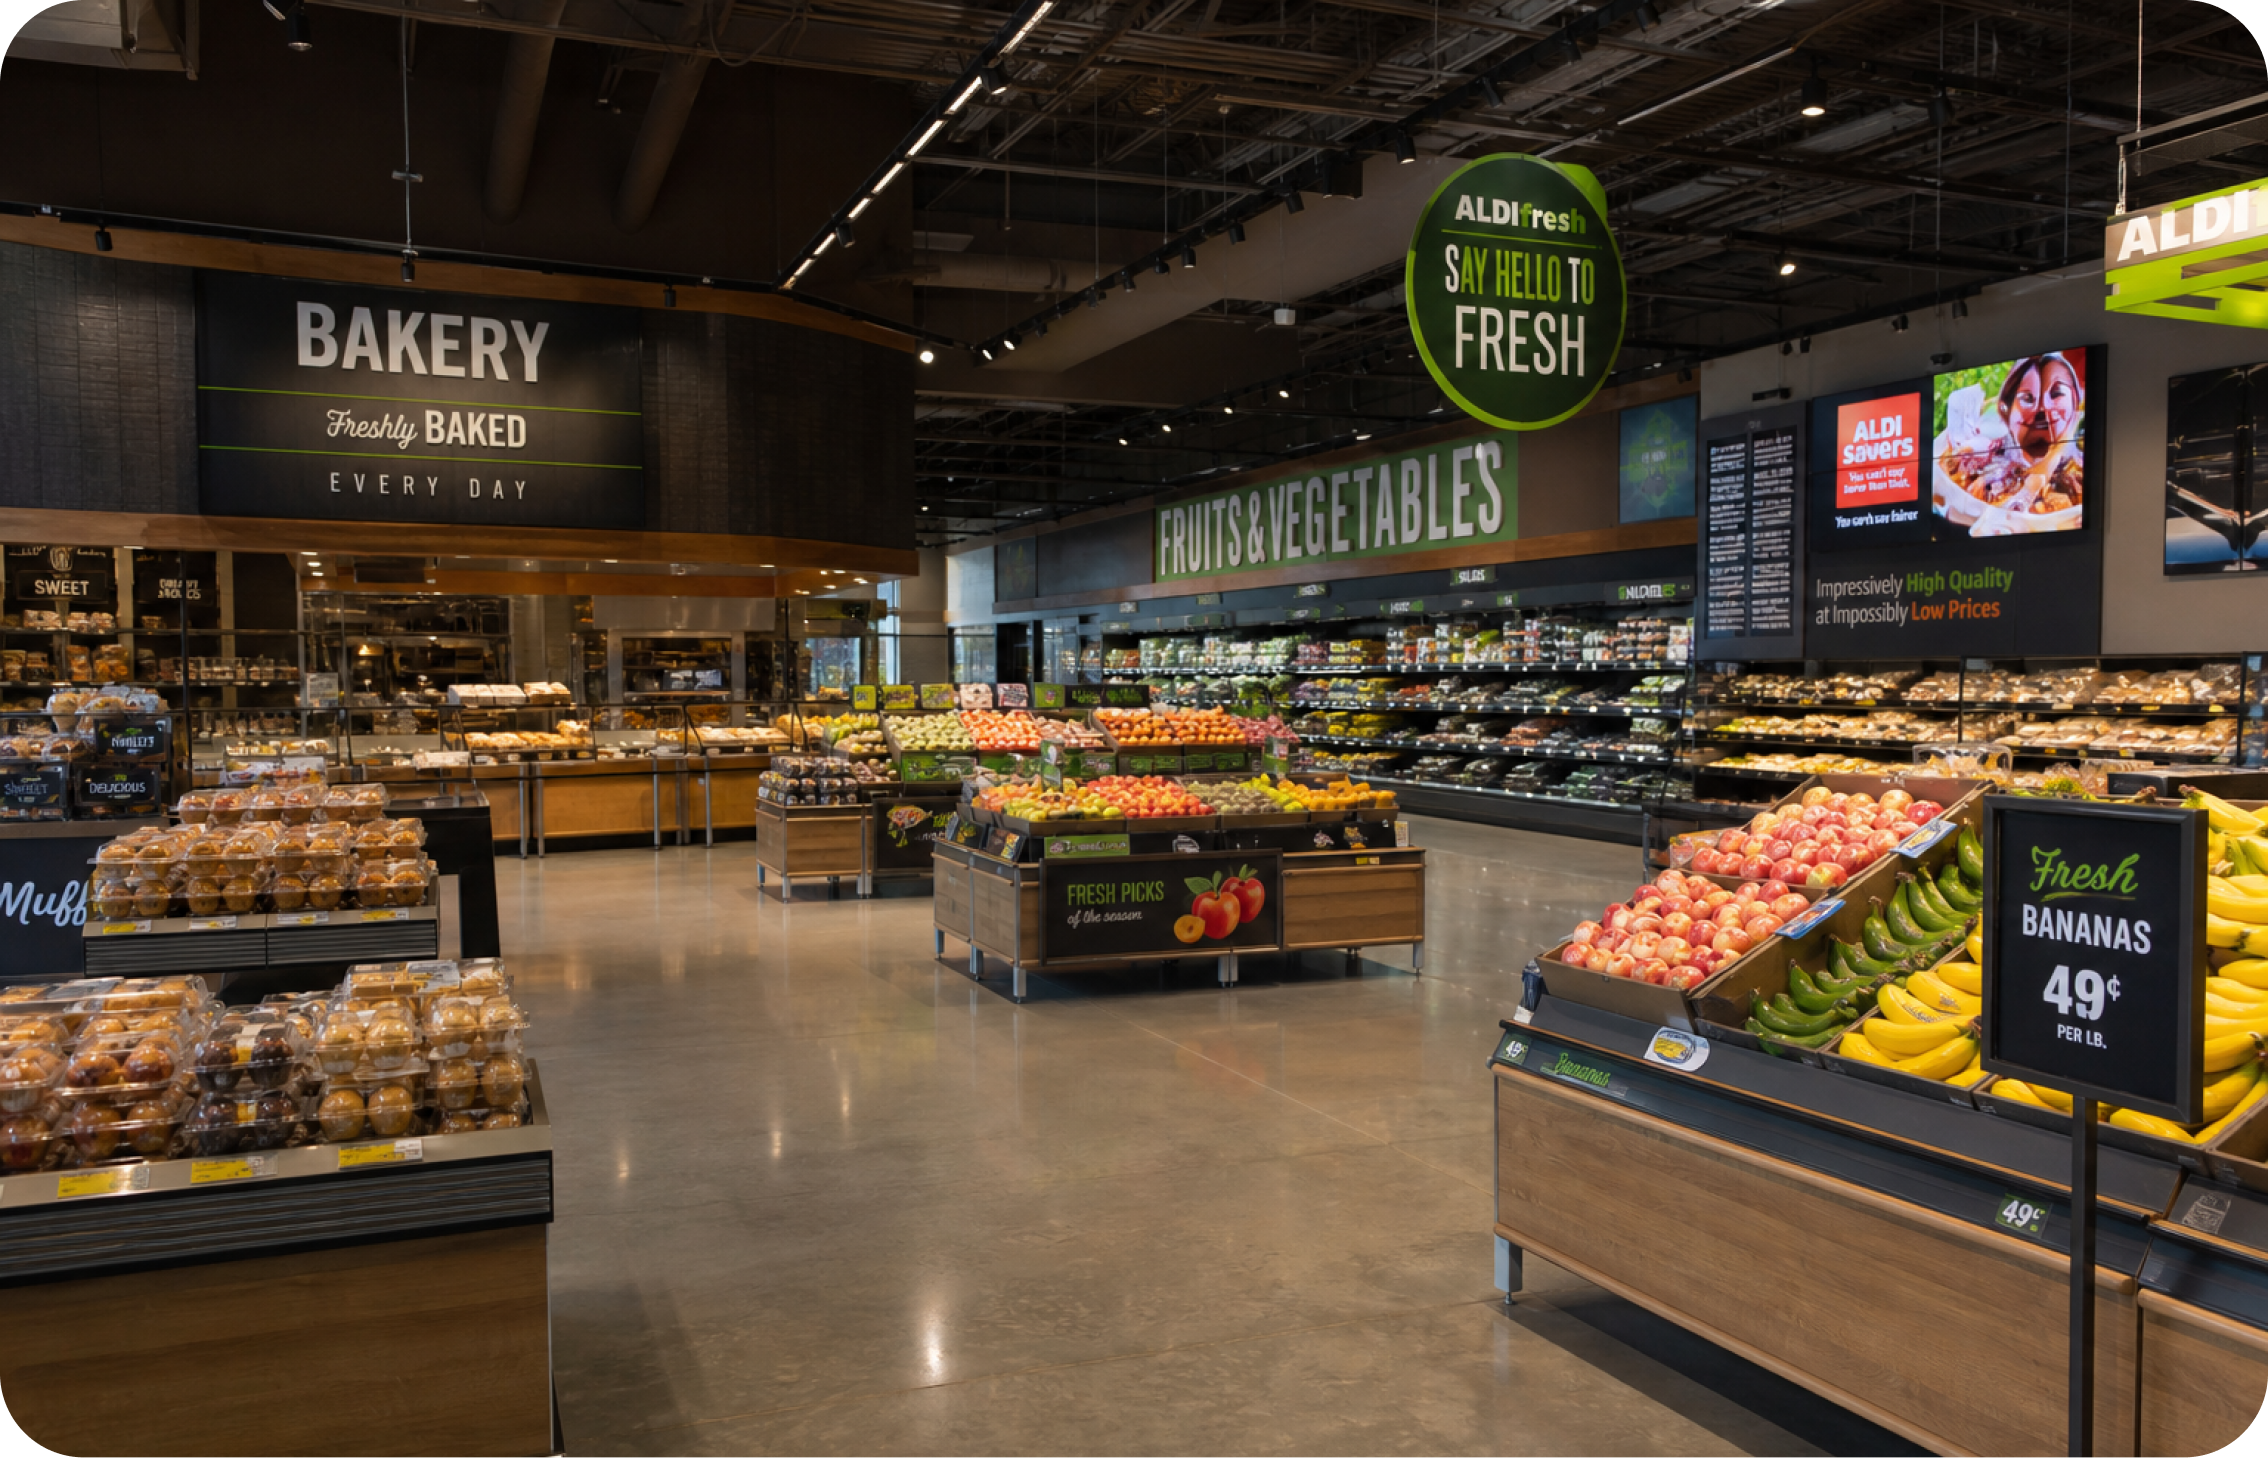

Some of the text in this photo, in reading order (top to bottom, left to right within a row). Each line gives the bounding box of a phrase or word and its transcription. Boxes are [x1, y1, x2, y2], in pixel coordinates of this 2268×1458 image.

[1445, 244, 1595, 305] SAY HELLO TO
[297, 301, 550, 383] BAKERY
[1455, 305, 1585, 377] FRESH
[326, 409, 527, 449] Freshly BAKED
[1853, 415, 1902, 443] ALDI
[330, 472, 527, 500] EVERY DAY
[34, 580, 90, 596] SWEET
[1816, 567, 2014, 601] Impressively High Quality
[1816, 598, 2001, 629] at Impossibly Low Prices
[2029, 846, 2140, 893] Fresh
[1067, 880, 1165, 906] FRESH PICKS
[1067, 909, 1081, 929] of
[1083, 908, 1101, 924] the
[2022, 904, 2151, 955] BANANAS
[2043, 964, 2122, 1021] 49¢
[2057, 1023, 2107, 1049] PER LB.
